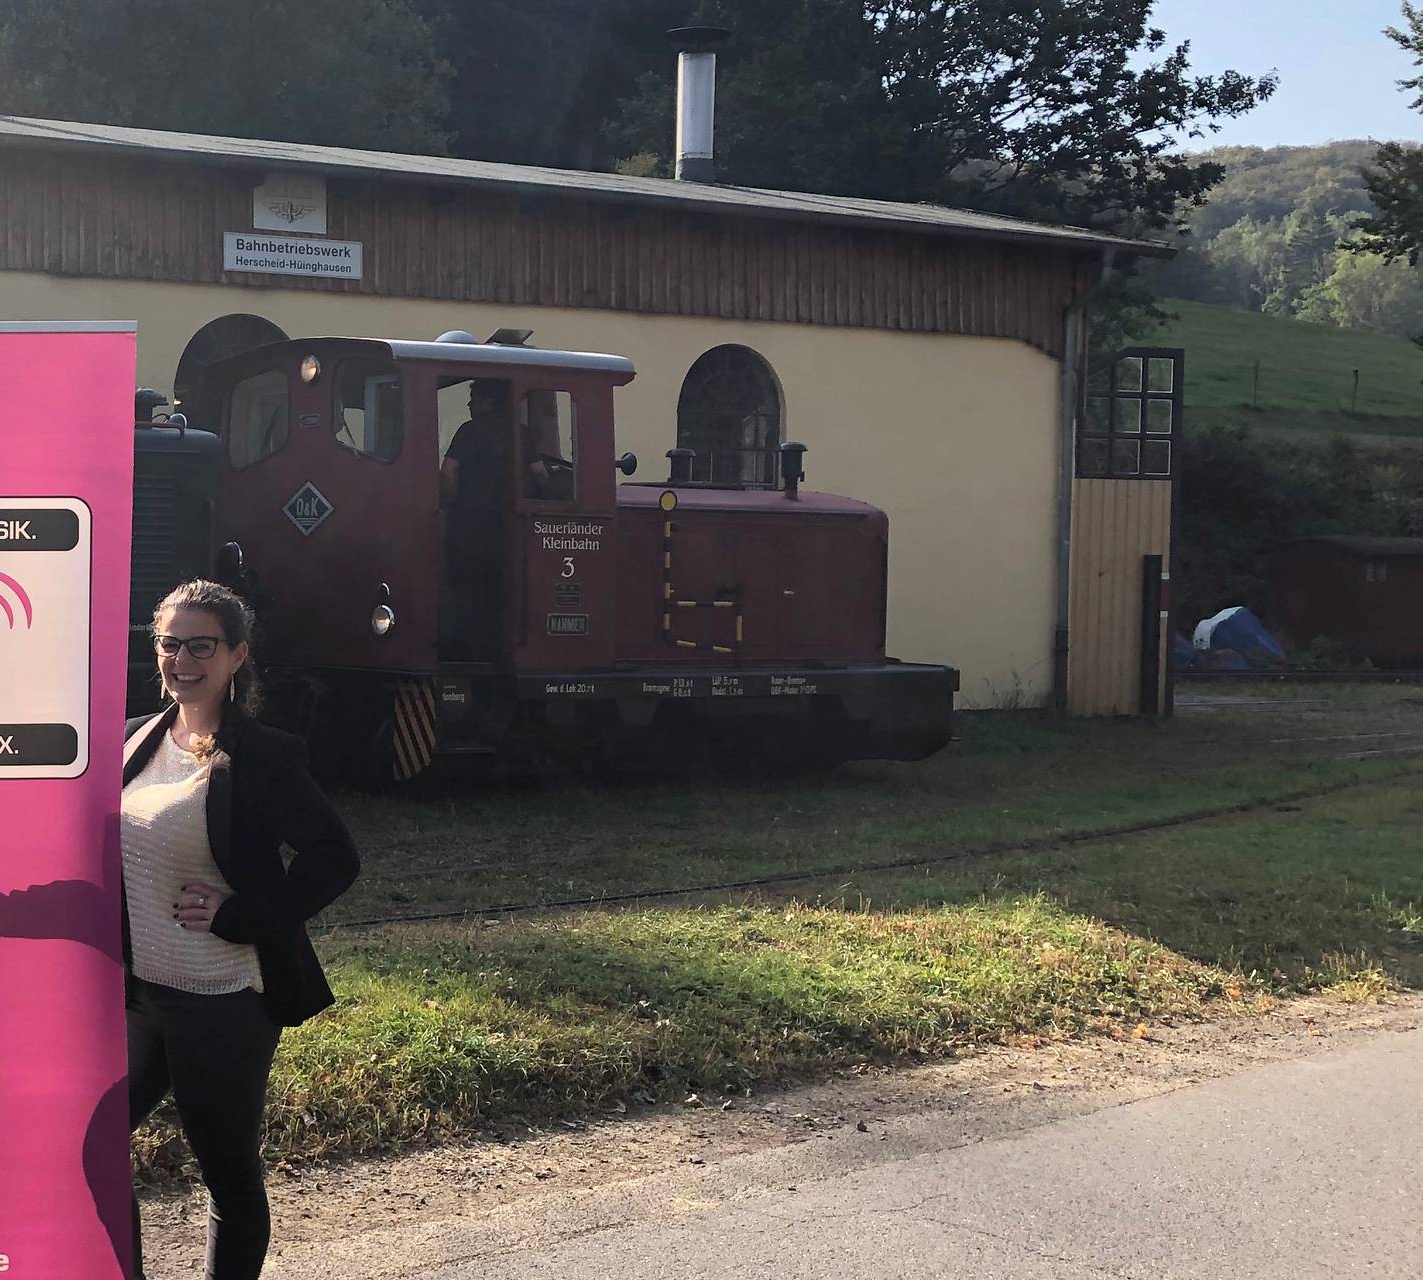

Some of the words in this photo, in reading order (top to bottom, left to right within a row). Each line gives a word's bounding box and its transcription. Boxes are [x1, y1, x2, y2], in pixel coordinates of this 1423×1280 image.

[236, 238, 352, 258] Bahnbetriebswerk
[235, 256, 352, 273] Herscheid-Hüinghausen
[534, 521, 604, 535] Sauerländer
[542, 537, 600, 550] Kleinbahn
[561, 557, 575, 578] 3
